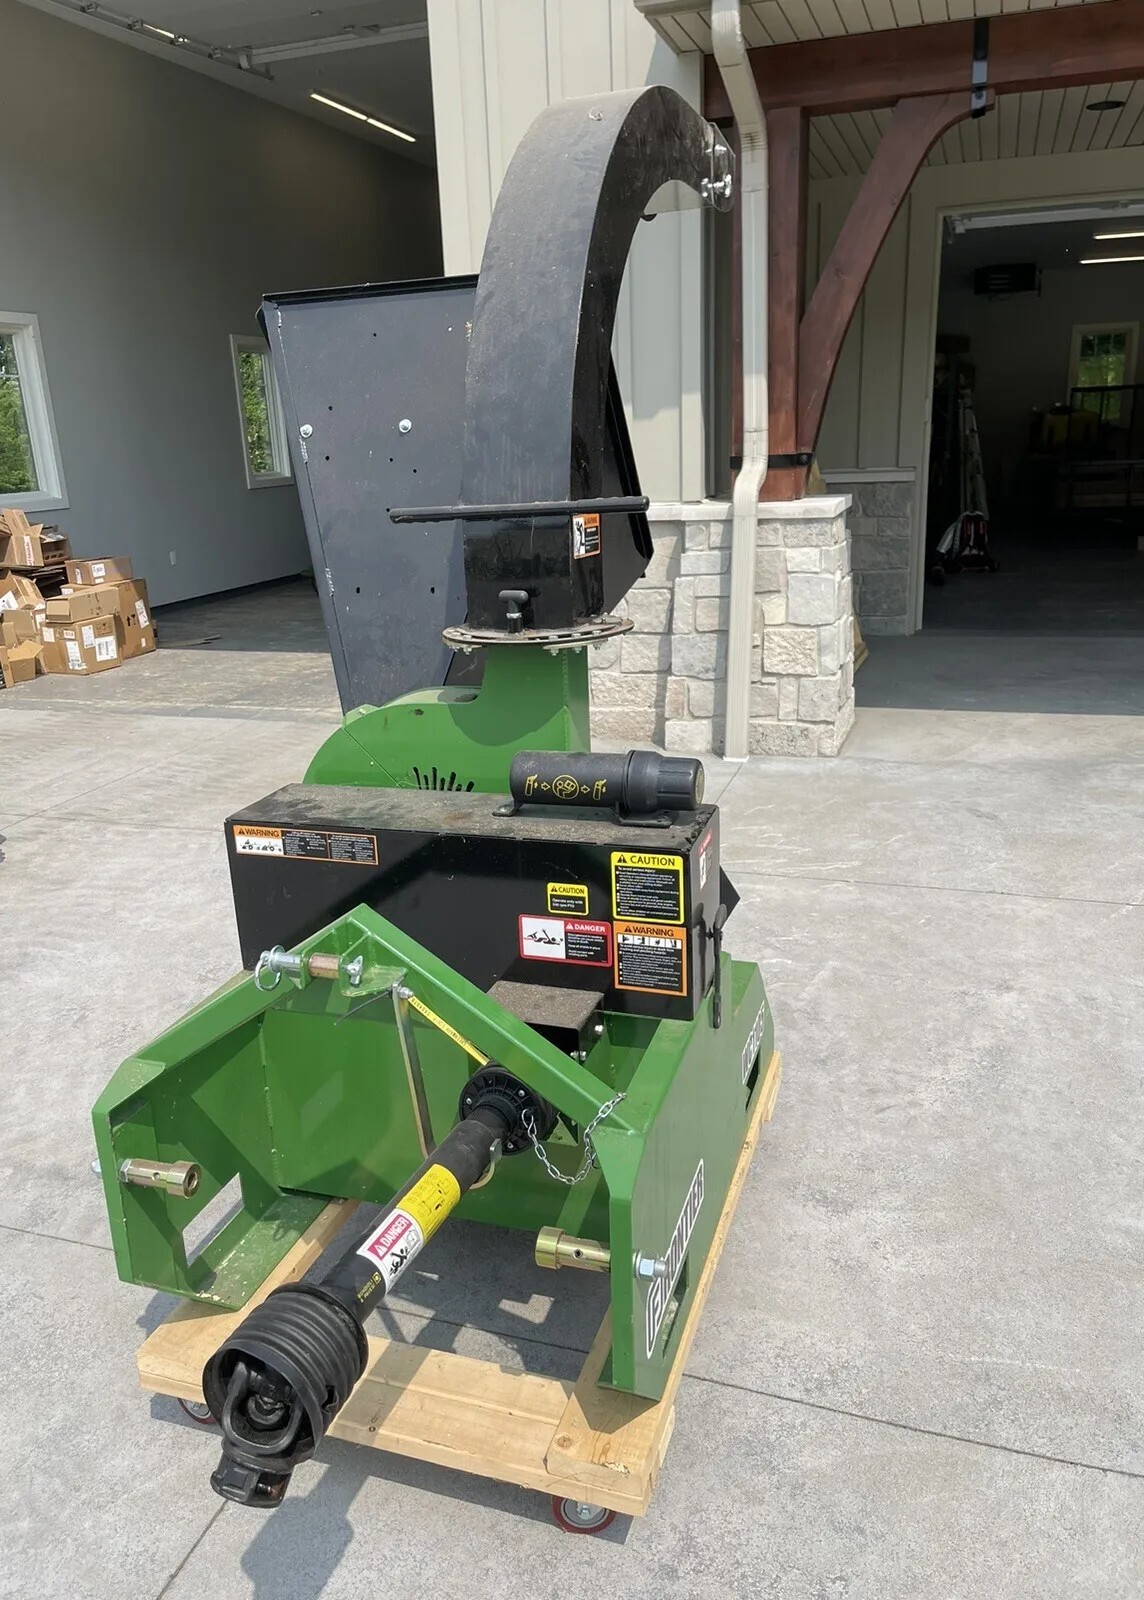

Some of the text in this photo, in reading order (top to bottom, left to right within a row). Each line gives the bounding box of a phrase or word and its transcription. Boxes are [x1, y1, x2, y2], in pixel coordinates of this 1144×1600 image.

[244, 828, 279, 837] WARNING
[630, 855, 675, 866] CAUTION
[574, 924, 605, 932] DANGER
[633, 926, 674, 937] WARNING
[379, 1216, 410, 1248] DANGER
[646, 1158, 704, 1360] FRONTIER
